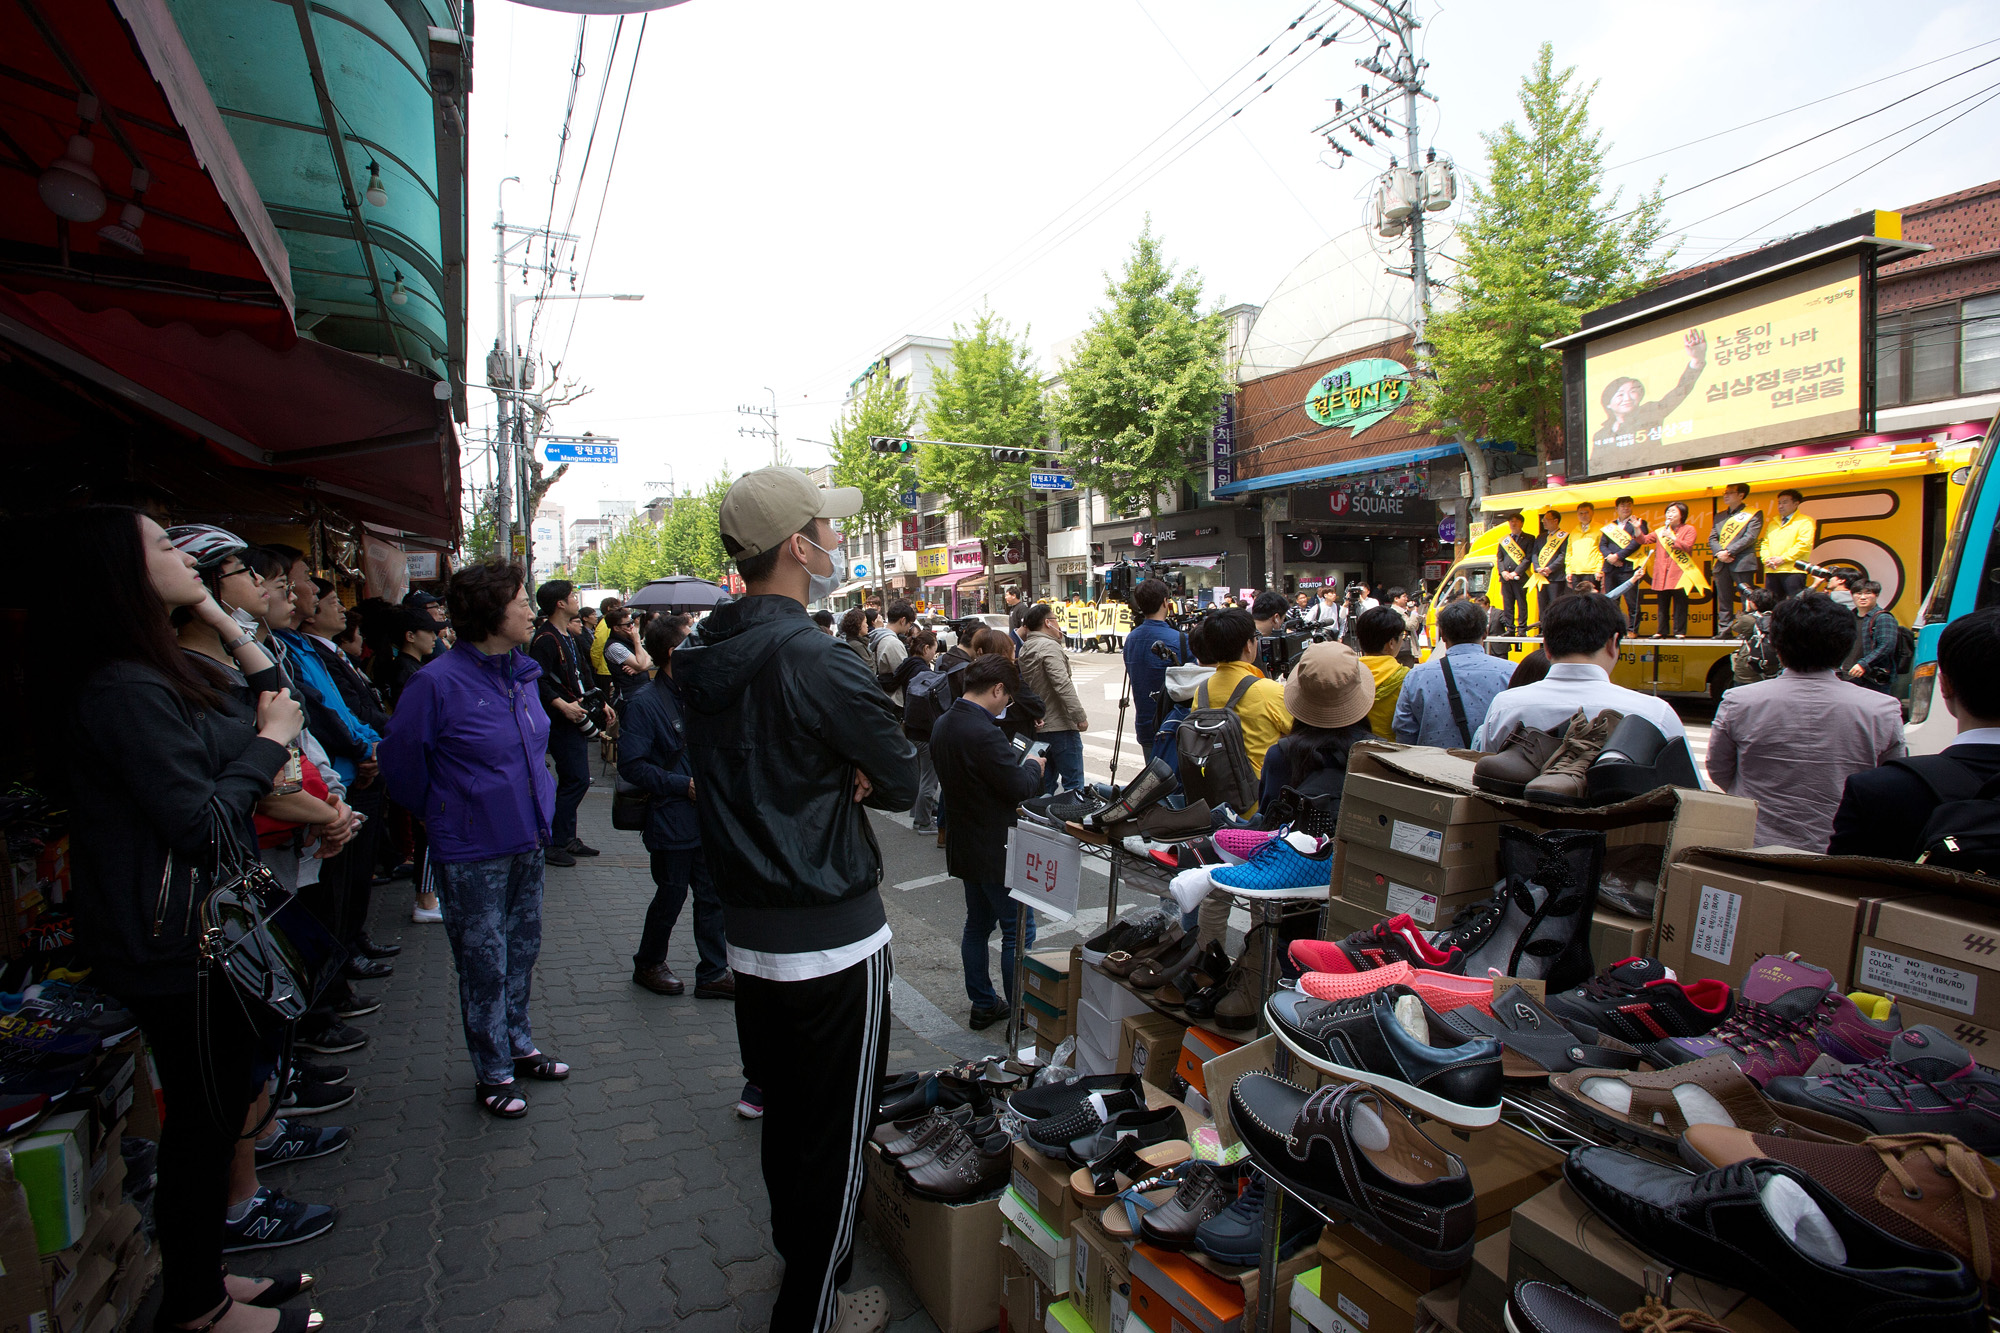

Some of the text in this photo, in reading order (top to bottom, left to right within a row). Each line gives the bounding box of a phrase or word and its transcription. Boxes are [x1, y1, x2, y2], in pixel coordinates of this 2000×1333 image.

[1714, 322, 1771, 350] 노동이
[1714, 327, 1819, 366] 당당한 나라
[1312, 379, 1402, 416] 월드컵시장
[1770, 377, 1845, 408] 연설중
[574, 446, 617, 457] 망원로8길
[1352, 494, 1404, 516] SQUARE
[929, 552, 946, 567] 부동산
[1026, 852, 1058, 893] 만원
[1696, 928, 1705, 949] STYLE
[1868, 958, 1894, 971] COLOR:
[1935, 976, 1966, 991] (BK/RD)
[1870, 950, 1901, 963] STYLE
[1932, 966, 1960, 979] 80-2
[1909, 978, 1928, 988] 240
